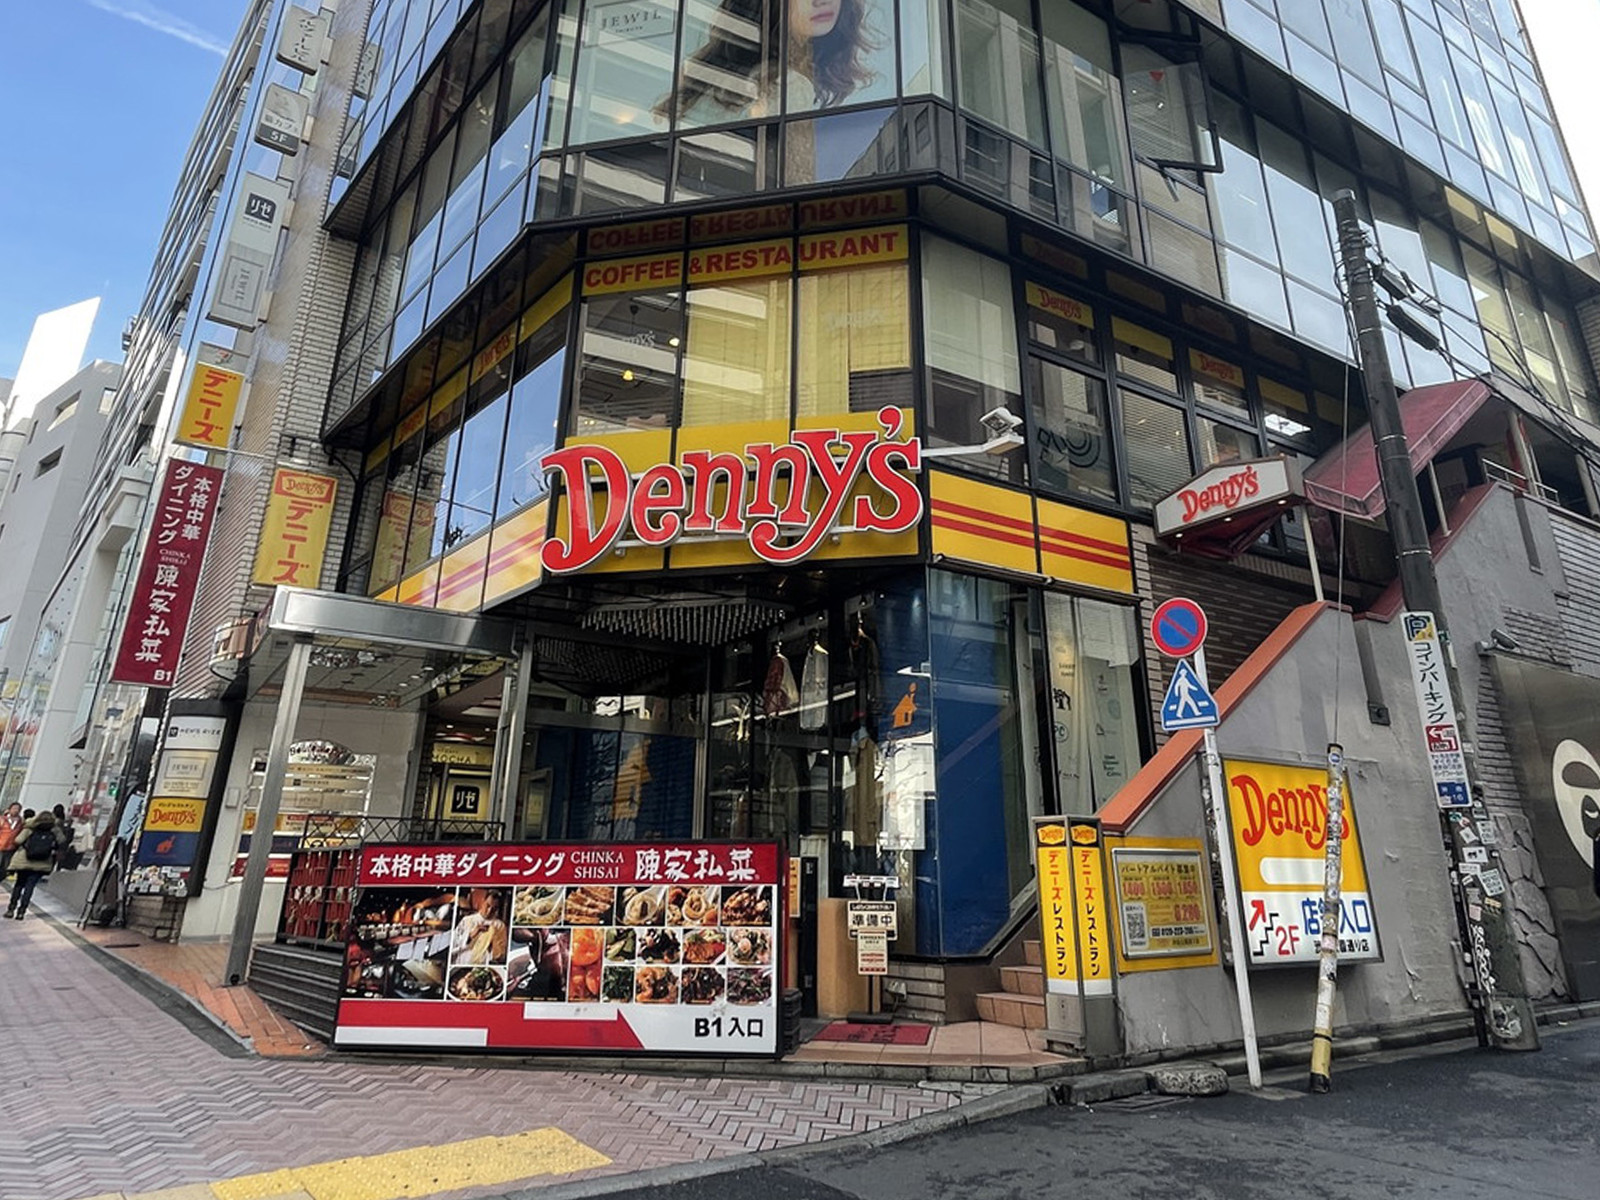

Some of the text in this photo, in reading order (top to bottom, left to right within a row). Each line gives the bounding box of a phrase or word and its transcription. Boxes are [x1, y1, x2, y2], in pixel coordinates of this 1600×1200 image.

[271, 131, 289, 143] 5F
[585, 231, 899, 288] COFFEE & RESTAURANT
[190, 369, 237, 442] デニーズ
[158, 465, 194, 546] ダイニング
[540, 405, 923, 573] Denny's
[1177, 465, 1261, 522] Denny's
[181, 477, 213, 541] 本格中華
[273, 499, 323, 584] デニーズ
[134, 563, 180, 663] 陳家私菜
[153, 669, 172, 682] B1
[150, 808, 198, 826] Denny's
[369, 852, 566, 878] 本格中華ダイニング
[570, 851, 625, 864] CHINKA
[574, 866, 619, 879] SHISAI
[635, 848, 756, 882] 陳家私菜
[1275, 925, 1300, 955] 2F
[695, 1016, 763, 1038] B1 入口
